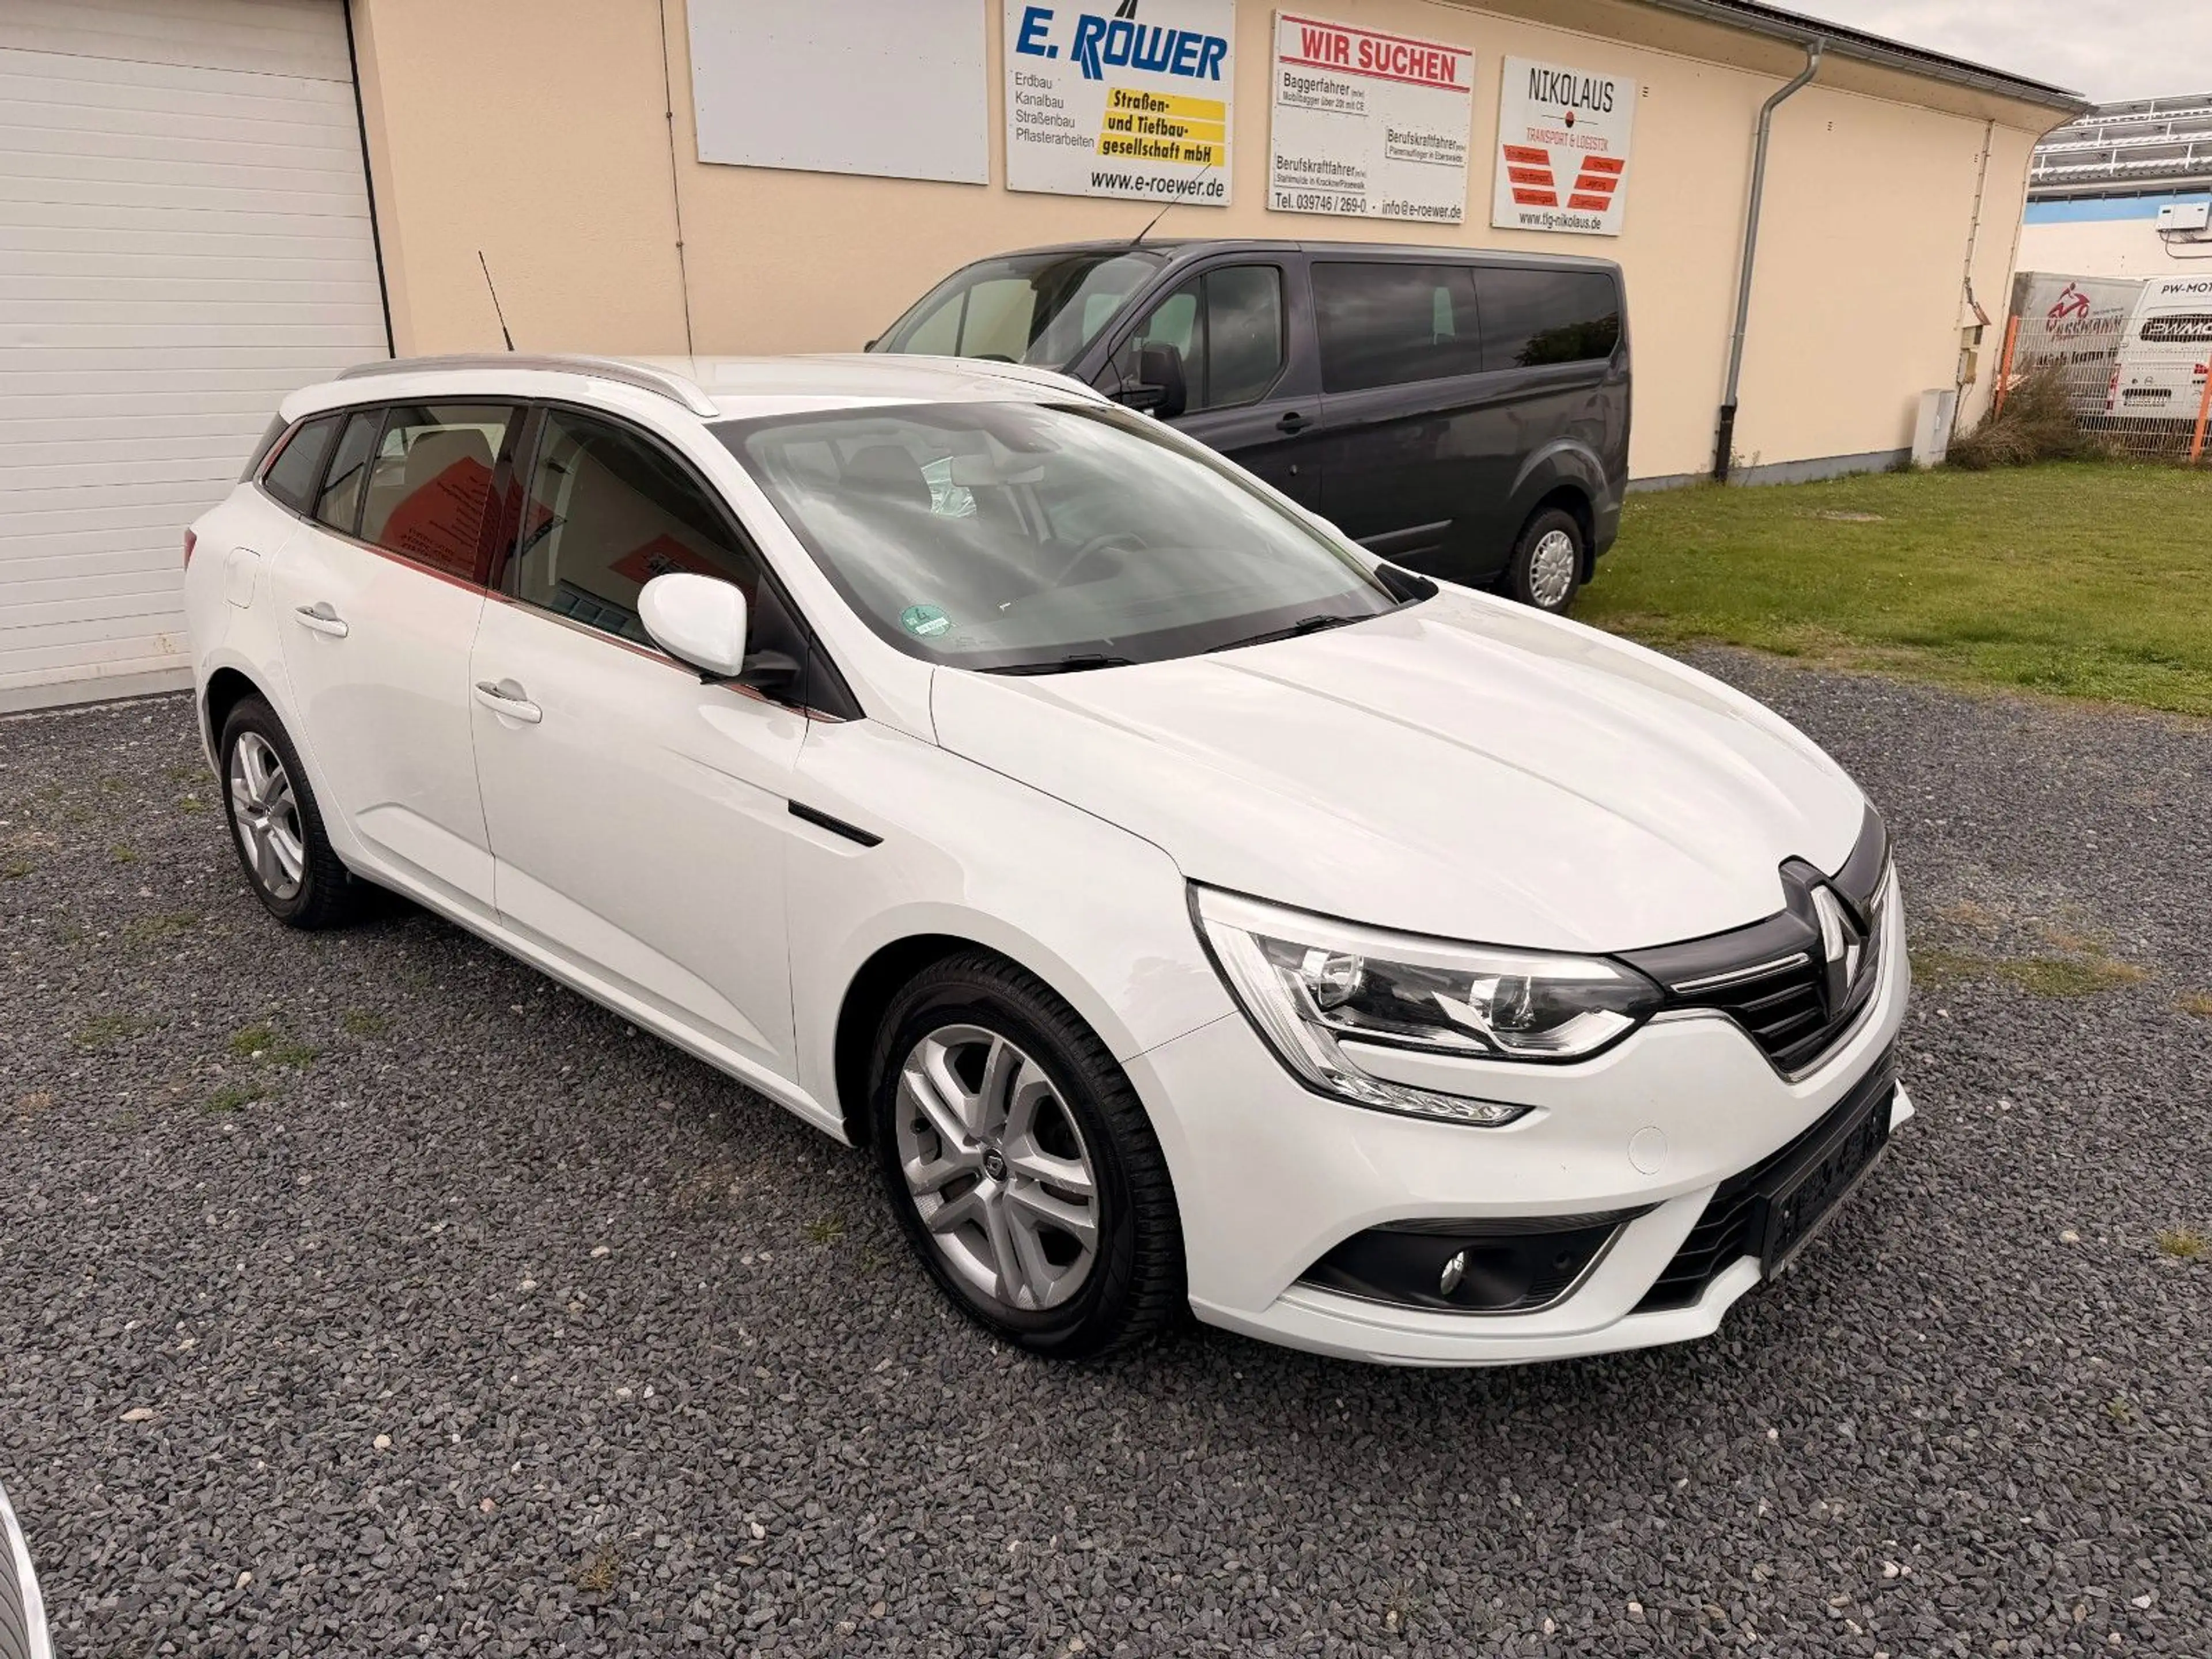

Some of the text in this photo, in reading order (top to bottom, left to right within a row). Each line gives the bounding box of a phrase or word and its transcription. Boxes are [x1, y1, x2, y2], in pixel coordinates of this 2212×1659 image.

[1016, 6, 1059, 58] E.
[1302, 28, 1456, 82] WIR SUCHEN
[1015, 71, 1052, 89] Erdbau
[1284, 72, 1350, 95] Baggerfahrer
[1529, 68, 1614, 112] NIKOLAUS
[1016, 90, 1064, 108] Kanalbau
[1114, 90, 1169, 112] Straßen-
[1016, 109, 1075, 128] Straßenbau
[1108, 115, 1188, 137] und Tiefbau-
[1016, 127, 1094, 147] Pflasterarbeiten
[1388, 128, 1457, 150] Berufskraftfahrer
[1527, 127, 1569, 145] TRANSPORT
[1103, 138, 1211, 162] gesellschaft mbH
[1277, 156, 1355, 176] Berufskraftfahrer
[1091, 172, 1224, 197] www.e-roewer.de
[1275, 192, 1294, 209] Tel.
[1297, 195, 1332, 211] 039746
[1340, 197, 1367, 213] 269-0
[1382, 200, 1462, 219] info@e-roewer.de
